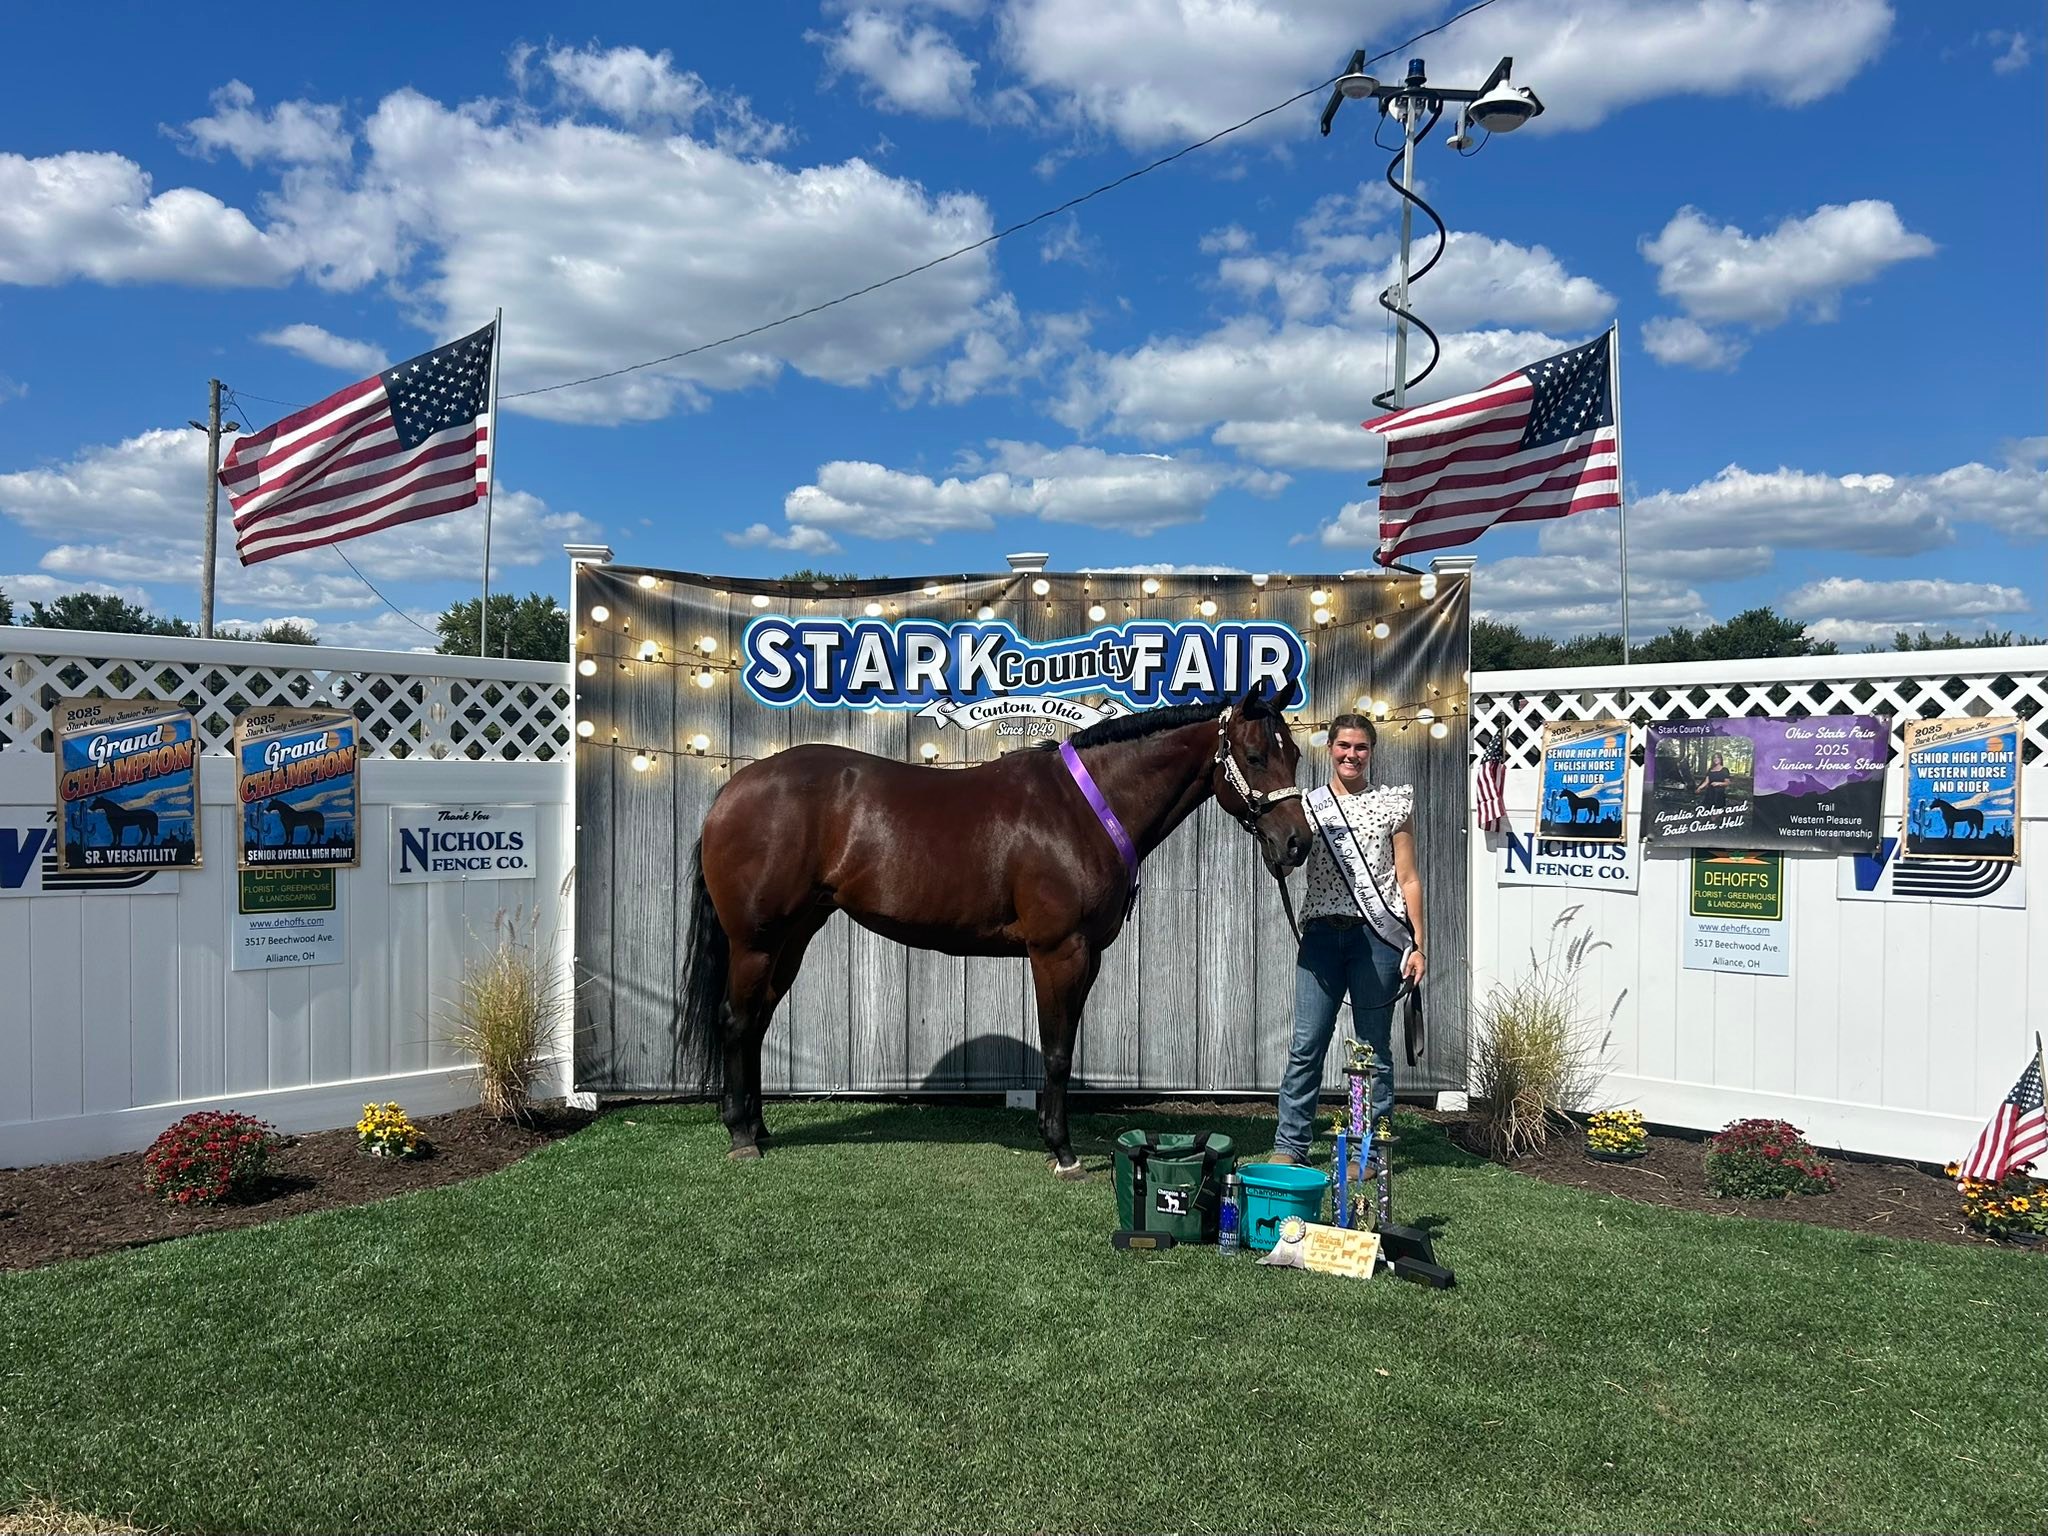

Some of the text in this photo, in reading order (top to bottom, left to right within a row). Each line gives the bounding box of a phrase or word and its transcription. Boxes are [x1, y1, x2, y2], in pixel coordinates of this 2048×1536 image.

[755, 628, 1290, 692] STARK County FAIR
[67, 706, 101, 721] 2025
[1042, 700, 1084, 721] Ohio
[66, 706, 159, 732] Stark County Junior Fair
[245, 714, 325, 738] Stark County Junior Fair
[246, 714, 276, 728] 2025
[996, 721, 1056, 736] Since 1849
[1551, 726, 1572, 737] 2025
[1658, 725, 1710, 735] Stark County's
[1785, 725, 1876, 739] Ohio State Fair
[1914, 724, 1943, 738] 2025
[1931, 731, 1953, 742] County
[1975, 721, 1991, 730] Fair
[88, 724, 164, 768] Grand
[264, 731, 328, 772] Grand
[1814, 744, 1849, 756] 2025
[1547, 748, 1624, 759] SENIOR HIGH POINT
[1910, 751, 2014, 764] SENIOR HIGH POINT
[60, 740, 197, 801] CHAMPION
[1553, 761, 1616, 771] ENGLISH HORSE
[1772, 757, 1885, 770] Junior Horse Show
[240, 746, 358, 803] CHAMPION
[1562, 774, 1605, 784] AND RIDER
[1917, 766, 2007, 779] WESTERN HORSE
[1932, 781, 1990, 793] AND RIDER
[1314, 797, 1334, 812] 2025
[1654, 809, 1694, 823] Amelia
[1725, 800, 1749, 813] and
[1817, 803, 1835, 811] Trail
[437, 810, 490, 821] Thank You
[1790, 815, 1862, 825] Western Pleasure
[1689, 820, 1717, 832] Outa
[1718, 815, 1744, 829] Hell
[1779, 828, 1873, 839] Western Horsemanship
[85, 848, 177, 864] SR. VERSATILITY
[247, 848, 352, 861] SENIOR OVERALL HIGH POINT
[399, 828, 524, 873] NICHOLS
[1504, 832, 1627, 874] NICHOLS
[432, 856, 528, 871] FENCE CO.
[1535, 862, 1629, 880] FENCE CO.
[1704, 871, 1769, 888] DEHOFF'S
[245, 885, 274, 894] FLORIST
[281, 883, 331, 892] GREENHOUSE
[1695, 890, 1723, 898] FLORIST
[1727, 891, 1777, 901] GREENHOUSE
[259, 894, 317, 903] & LANDSCAPING
[1354, 881, 1386, 929] Ambassador
[1713, 901, 1763, 909] LANDSCAPING
[249, 917, 325, 930] www.dehoffs.com
[1698, 923, 1771, 937] www.dehoffs.com
[245, 938, 266, 946] 3517
[268, 934, 316, 945] Beechwood
[1694, 938, 1781, 953] 3517 Beechwood Ave.
[266, 952, 315, 963] Alliance, OH
[1712, 957, 1760, 968] Alliance, OH
